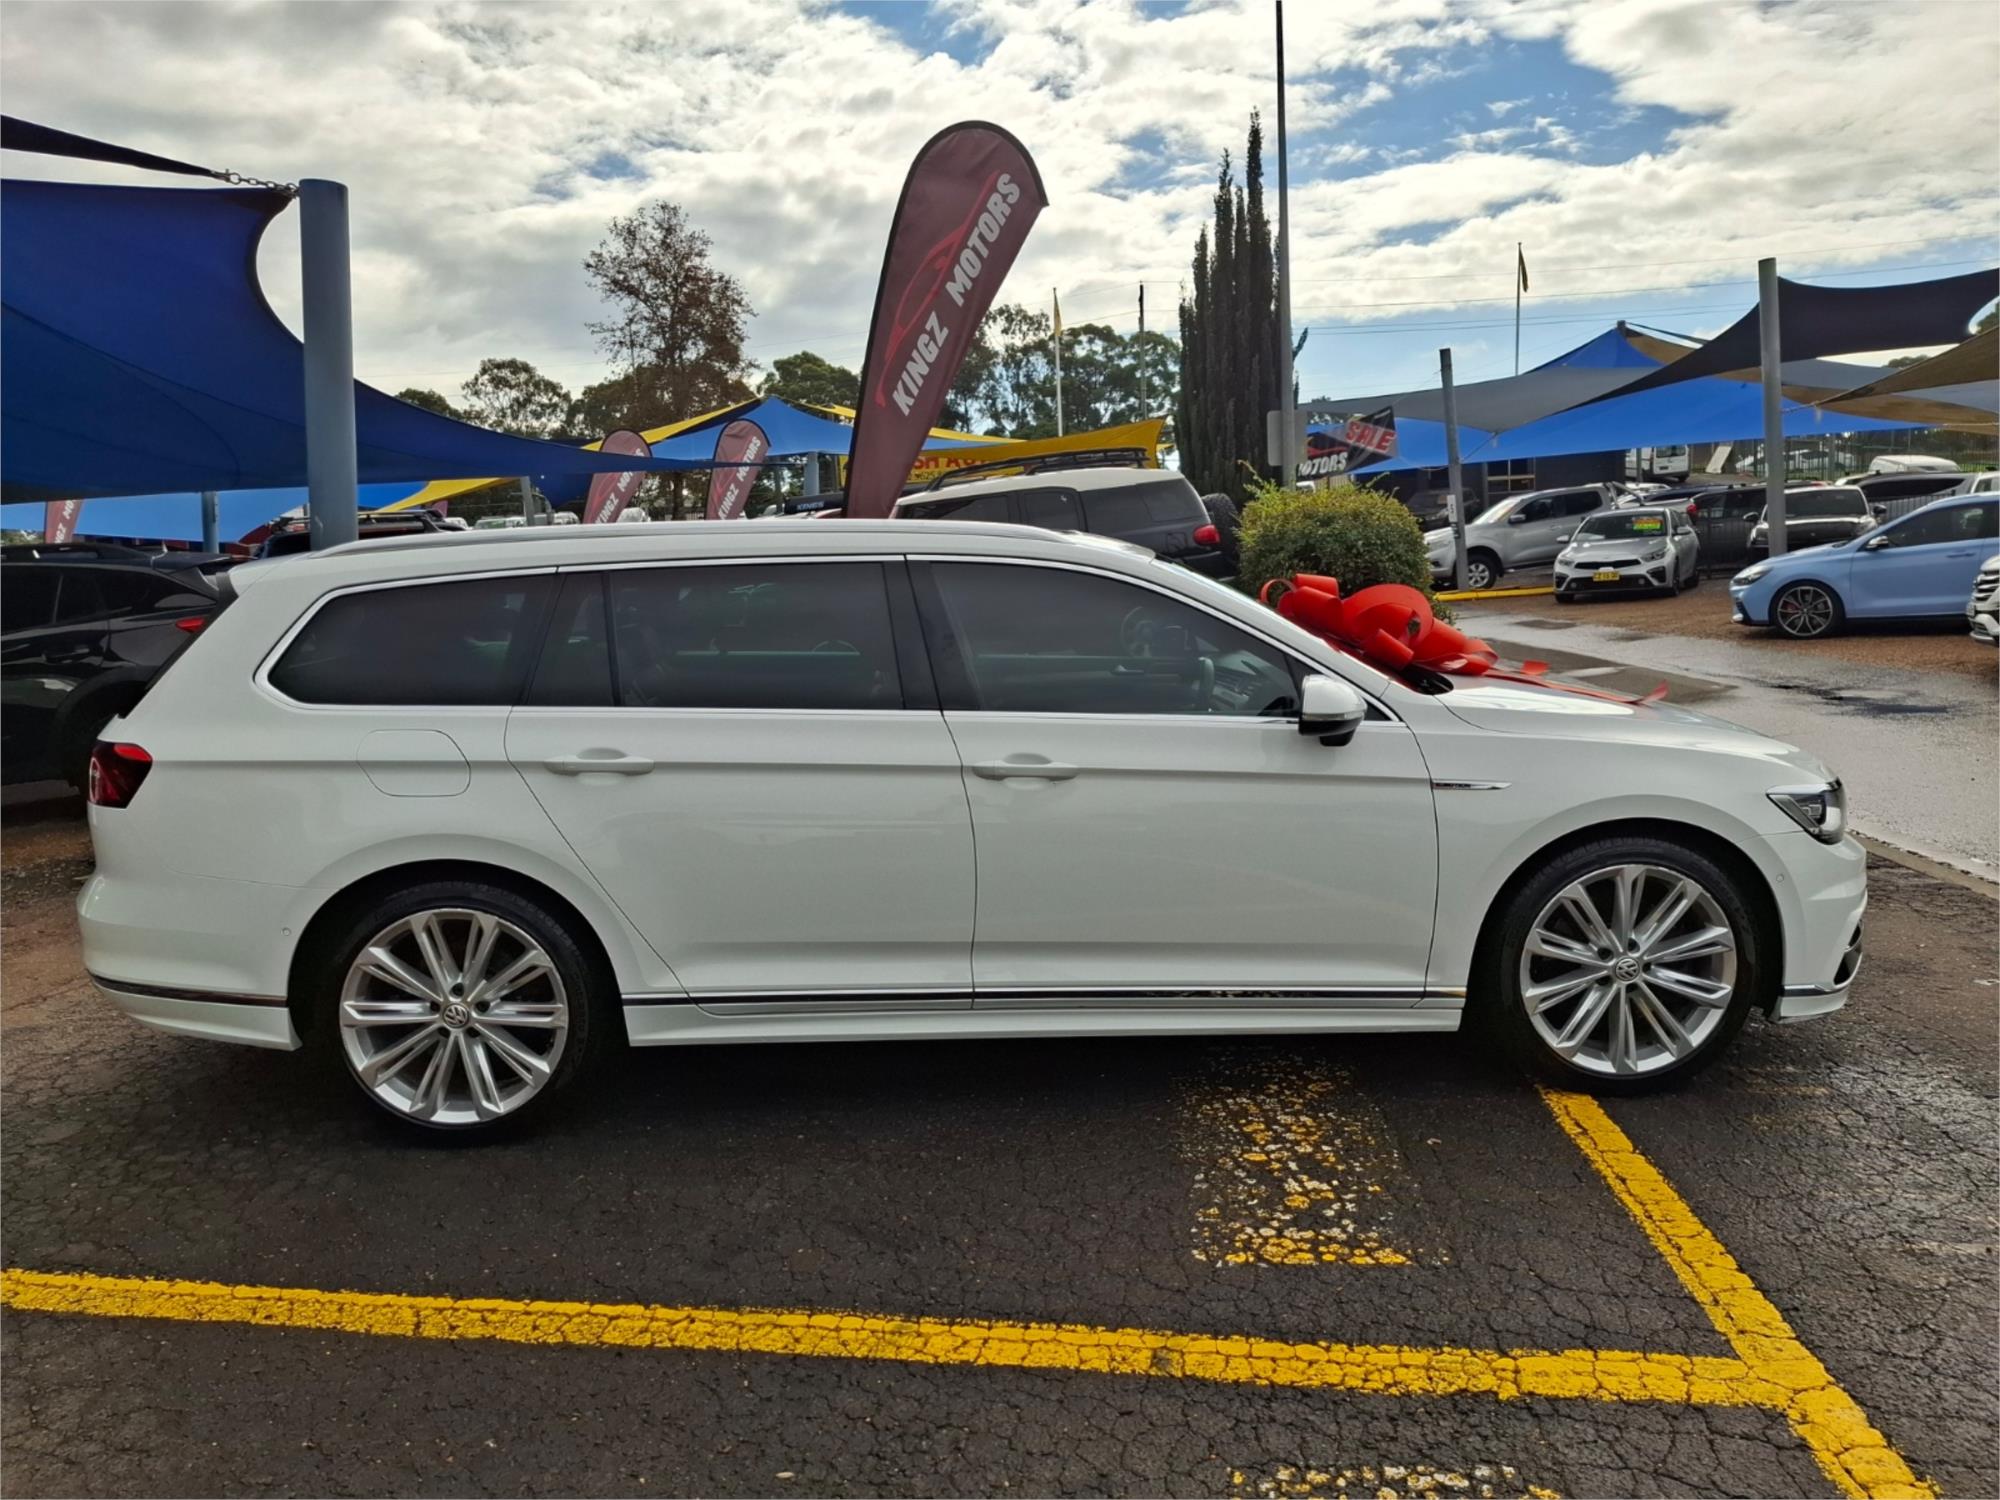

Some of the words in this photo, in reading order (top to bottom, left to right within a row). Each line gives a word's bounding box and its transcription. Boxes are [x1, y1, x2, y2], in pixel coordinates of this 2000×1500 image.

[892, 311, 949, 416] KINGZ
[945, 173, 1021, 306] MOTORS
[1345, 421, 1396, 451] SALE
